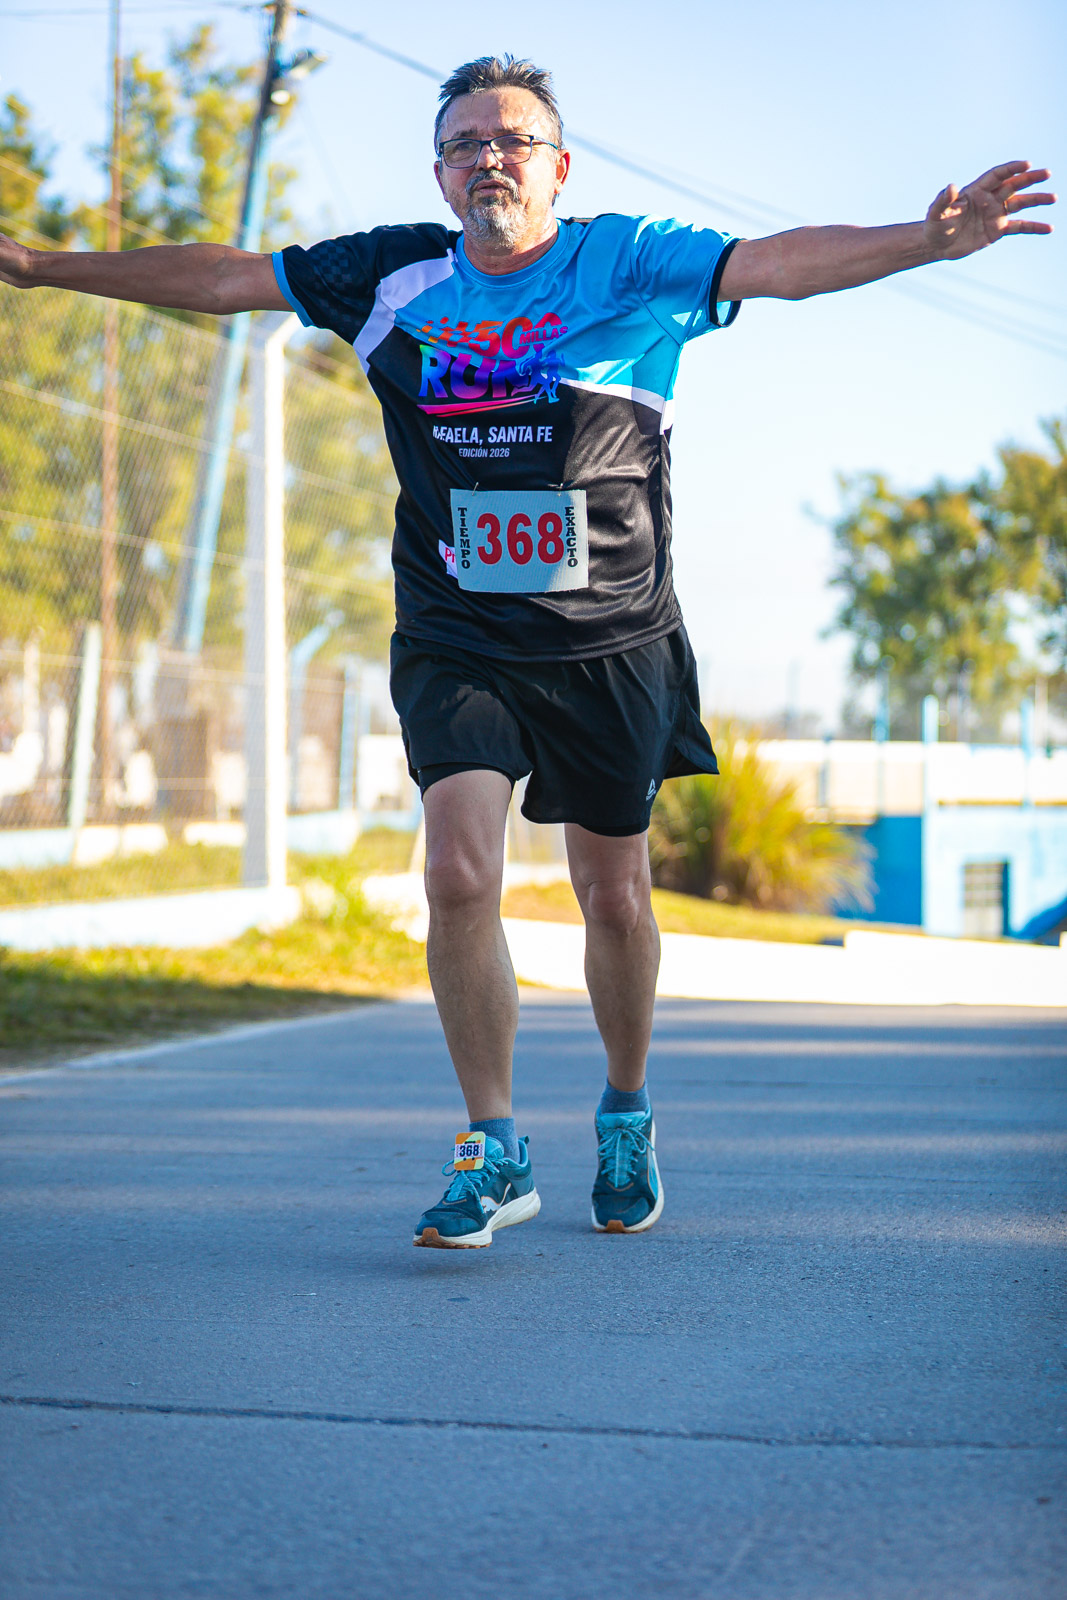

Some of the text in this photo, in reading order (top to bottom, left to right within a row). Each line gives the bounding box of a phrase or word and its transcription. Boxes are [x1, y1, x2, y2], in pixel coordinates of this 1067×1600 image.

[519, 326, 568, 345] MILLAS
[487, 426, 534, 443] SANTA
[536, 425, 553, 443] FE
[458, 446, 510, 458] EDICIÓN 2026
[457, 507, 471, 569] TIEMPO
[476, 512, 565, 565] 368
[564, 506, 579, 568] EXACTO
[459, 1144, 480, 1157] 368
